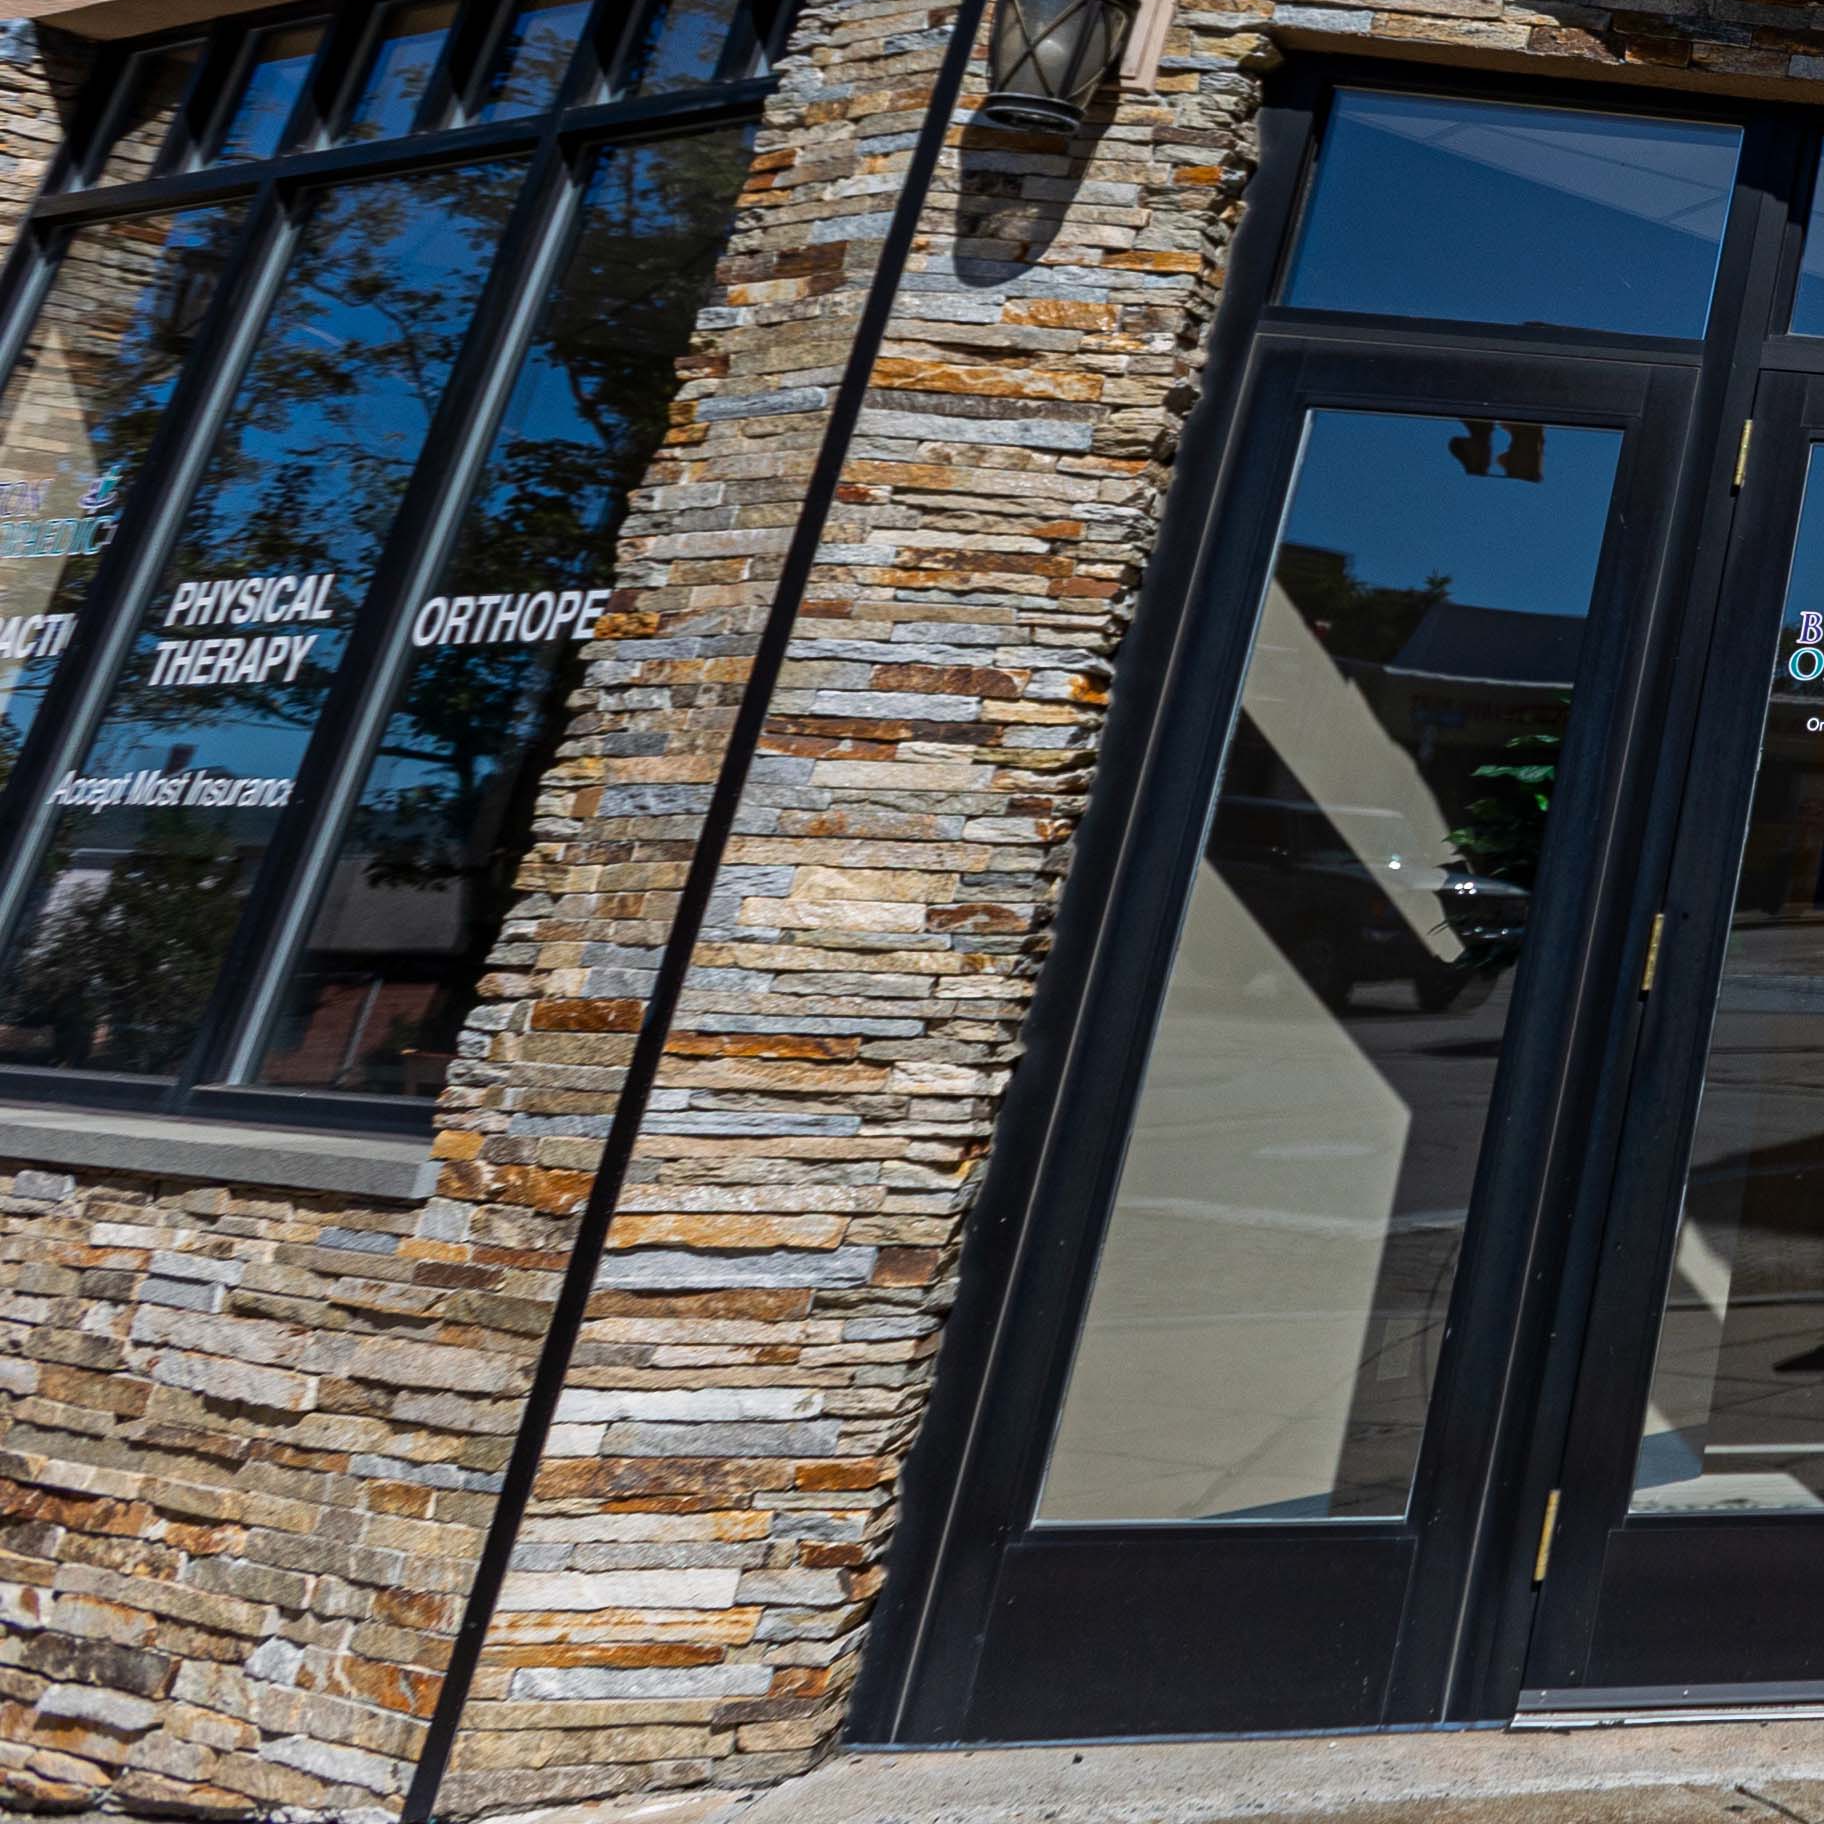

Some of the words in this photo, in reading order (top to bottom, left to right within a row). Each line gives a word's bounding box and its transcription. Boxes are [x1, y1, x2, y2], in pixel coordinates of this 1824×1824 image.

[164, 574, 335, 626] PHYSICAL
[412, 589, 611, 647] ORTHOPE
[149, 634, 318, 686] THERAPY
[46, 769, 134, 814] Accept
[125, 770, 192, 807] Most
